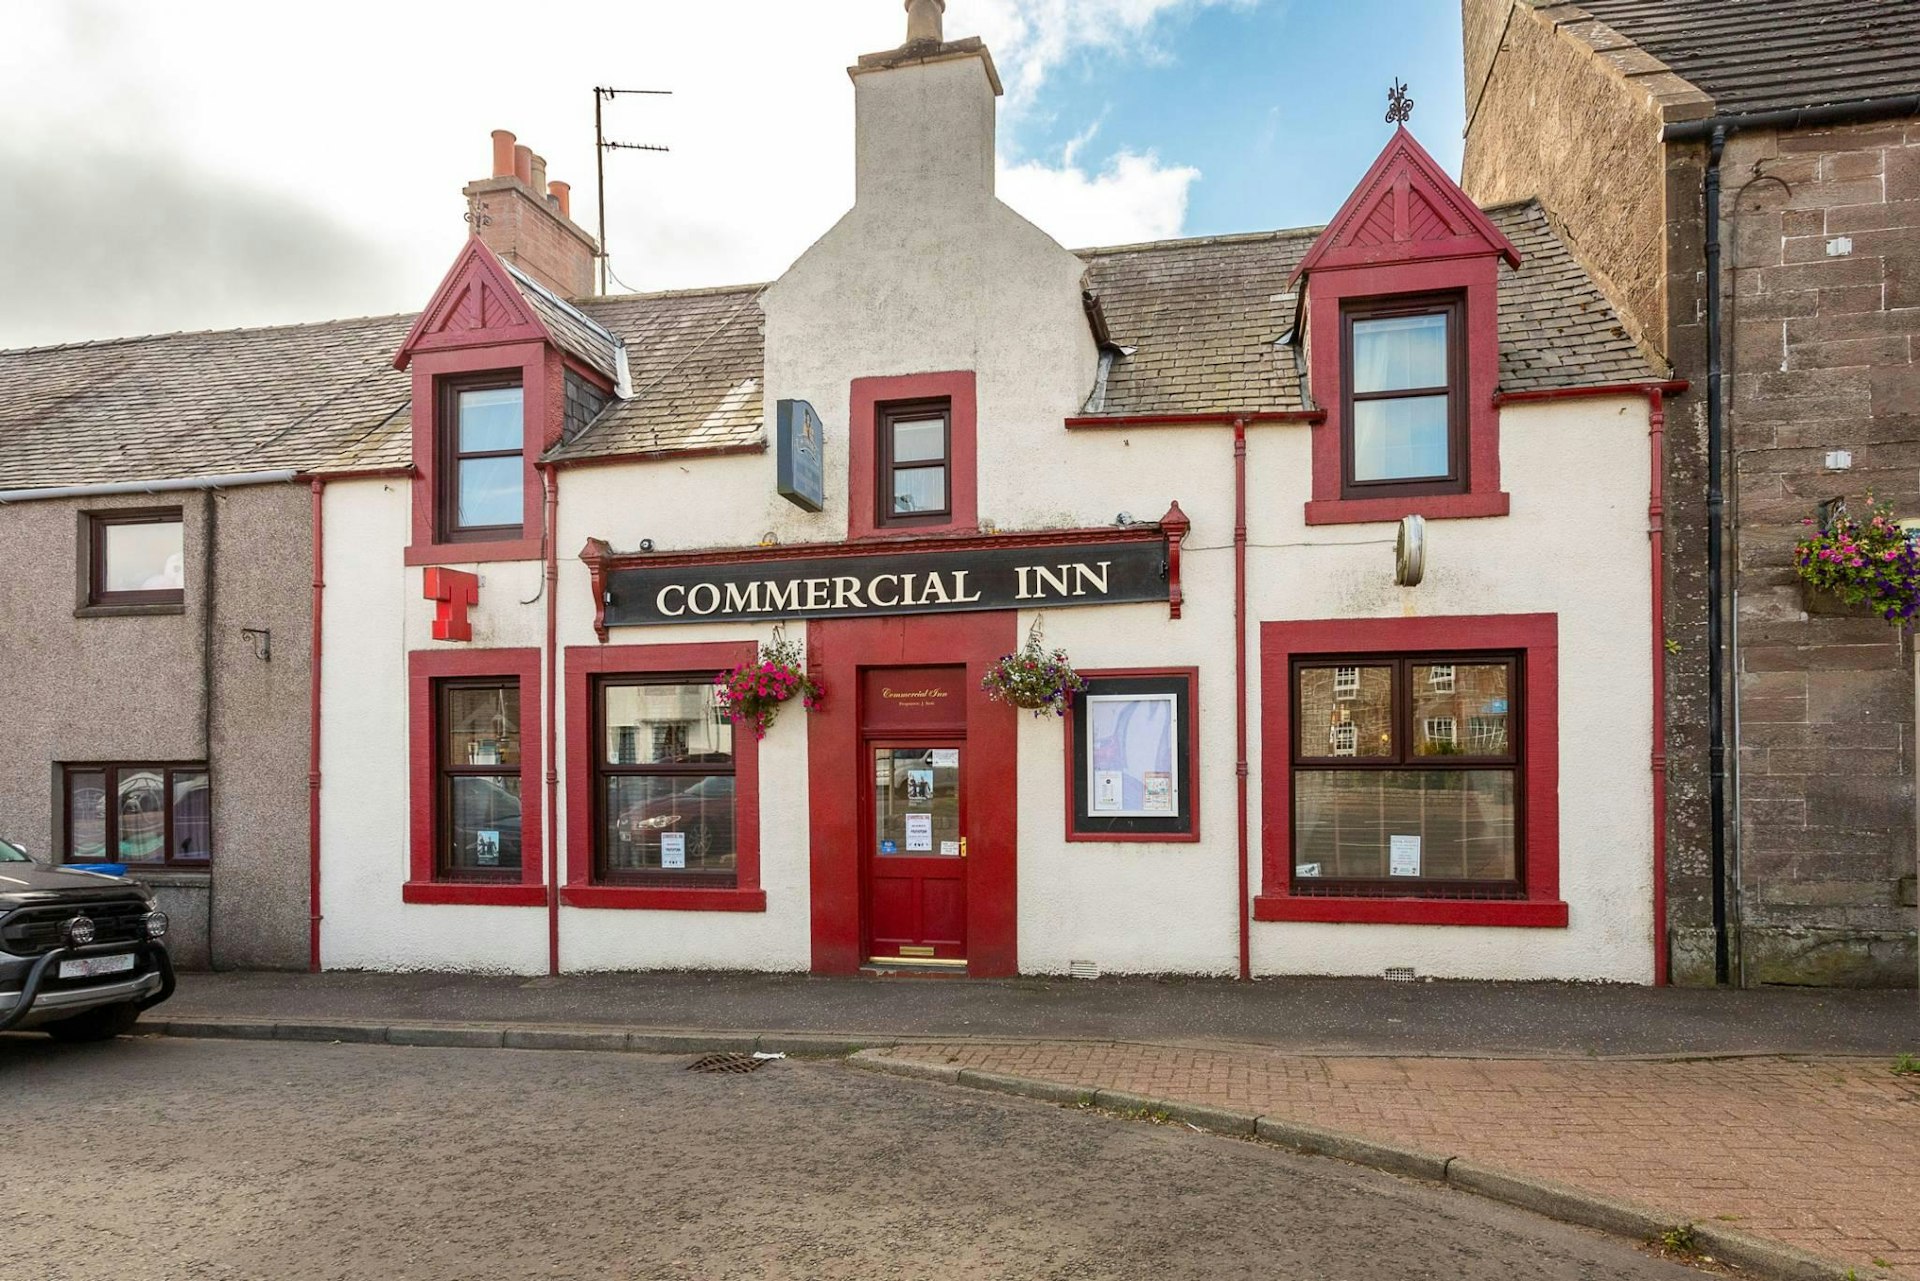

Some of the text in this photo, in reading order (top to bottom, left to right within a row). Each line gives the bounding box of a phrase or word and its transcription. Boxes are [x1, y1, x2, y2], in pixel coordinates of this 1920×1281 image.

[424, 566, 479, 642] T
[656, 561, 1112, 617] COMMERCIAL INN
[882, 687, 948, 699] Commercial Inn
